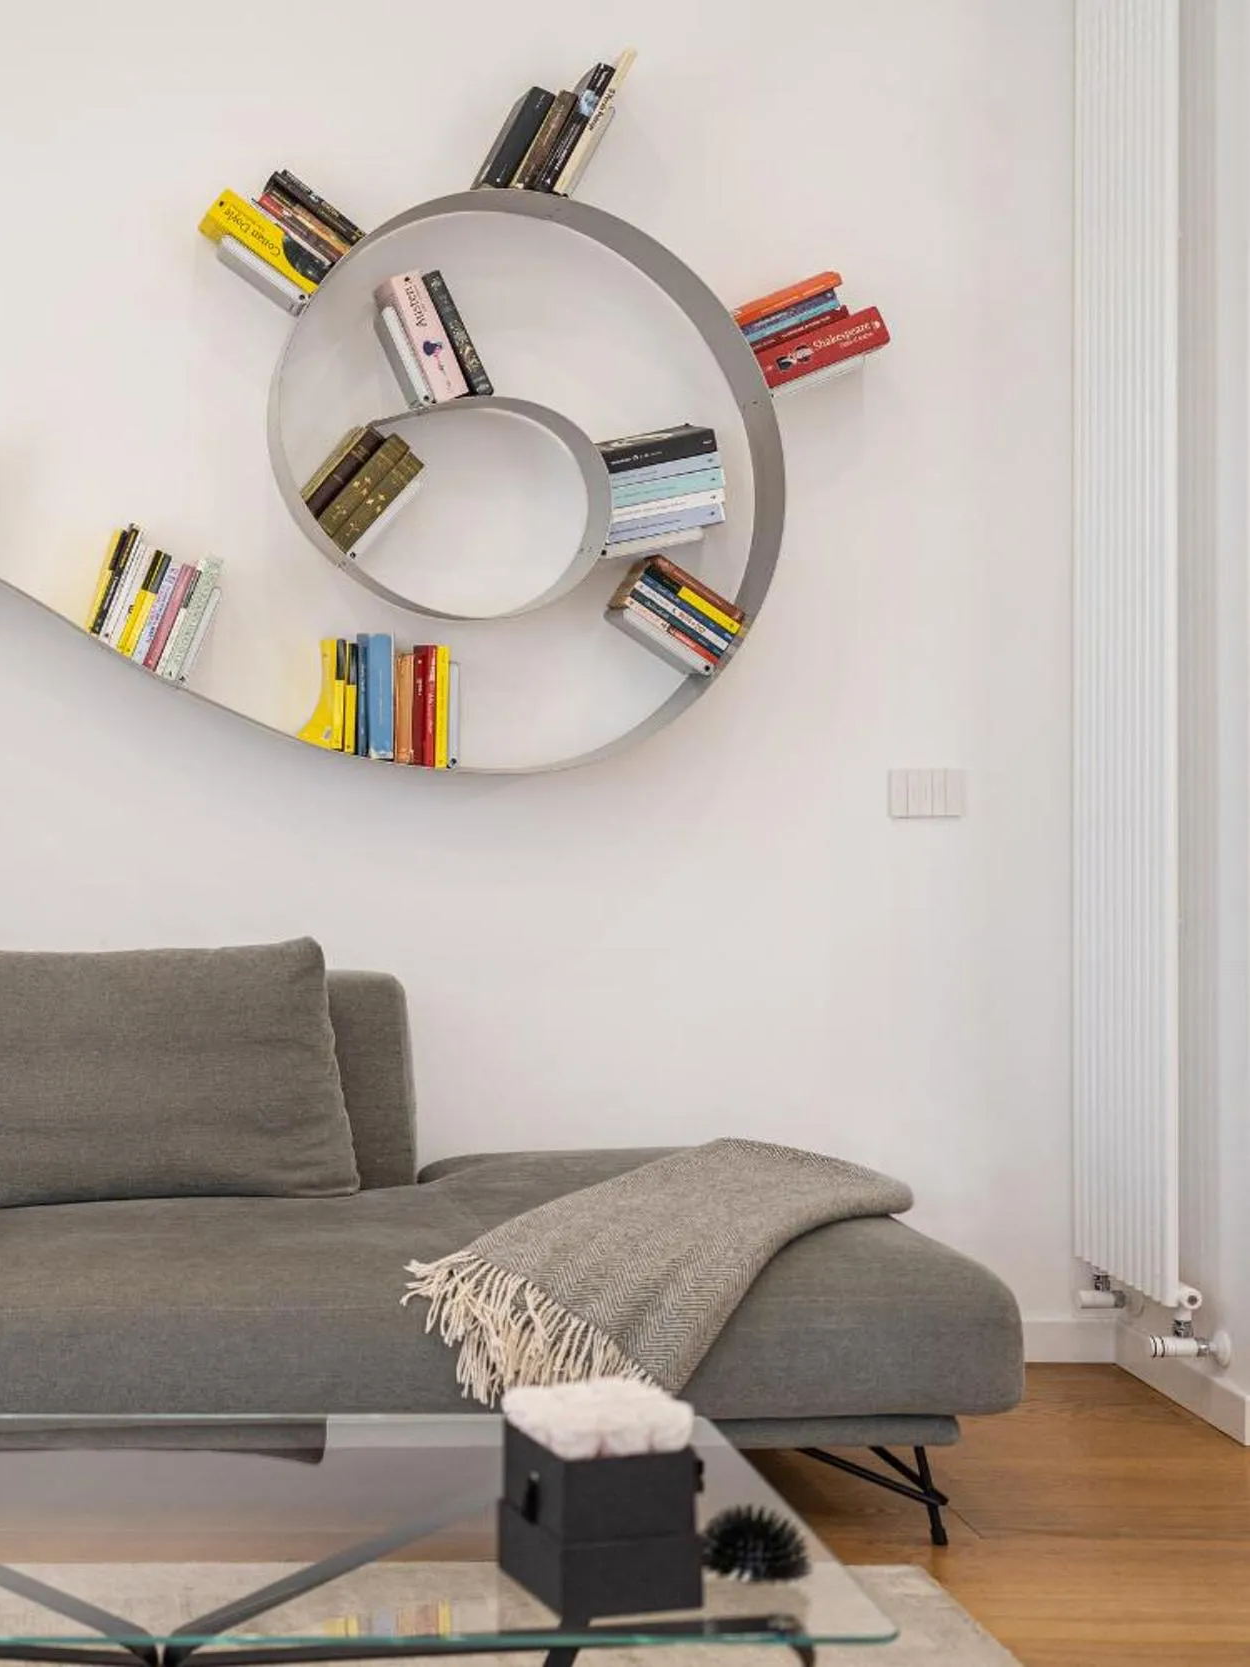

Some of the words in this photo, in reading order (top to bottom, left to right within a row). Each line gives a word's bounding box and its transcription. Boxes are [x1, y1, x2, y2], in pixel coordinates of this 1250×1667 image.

[224, 208, 252, 234] Doyle
[251, 231, 280, 257] Conan
[404, 285, 428, 328] Austen
[812, 323, 871, 349] Shakespeare
